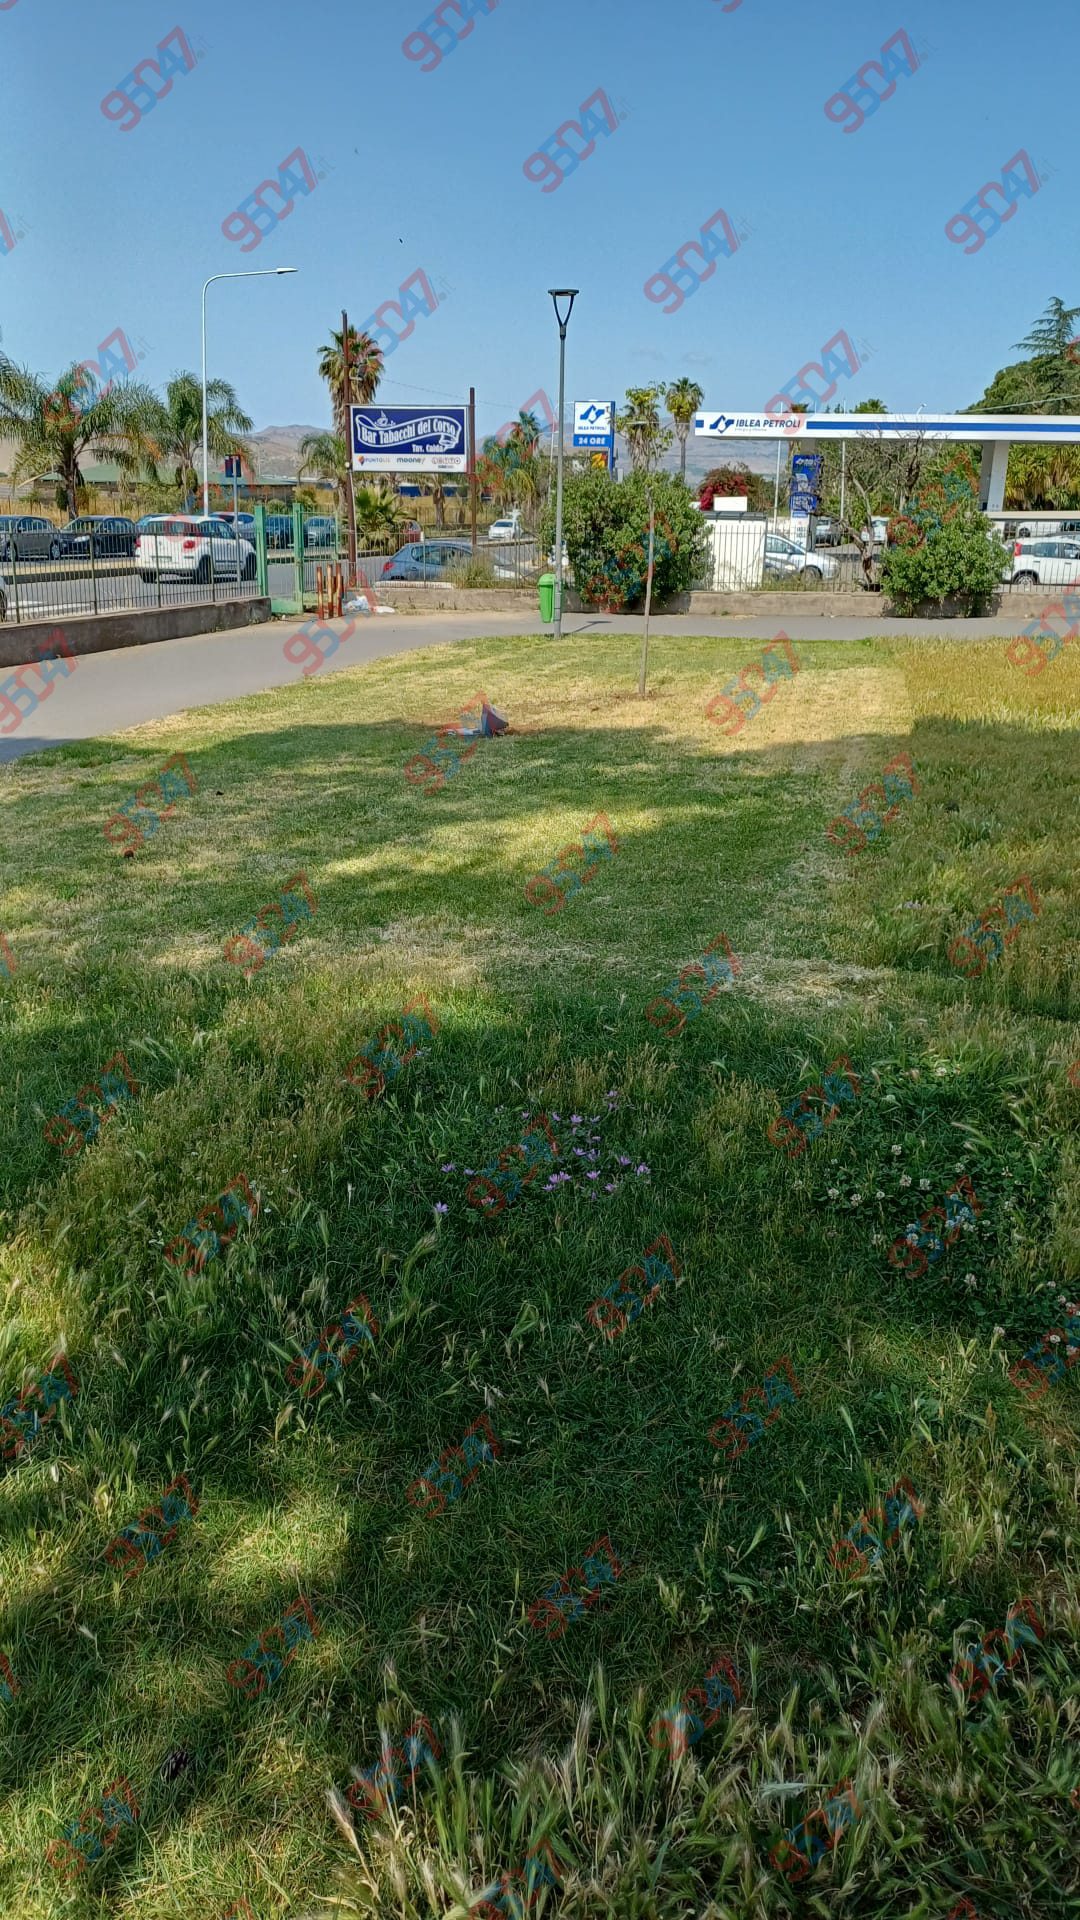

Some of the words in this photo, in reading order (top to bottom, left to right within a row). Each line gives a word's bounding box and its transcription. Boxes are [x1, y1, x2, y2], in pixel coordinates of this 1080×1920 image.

[736, 419, 761, 428] IBLEA
[763, 419, 801, 428] PETROLI
[362, 427, 377, 444] Bar
[379, 423, 415, 444] Tabacchi
[418, 419, 431, 435] del
[433, 419, 456, 436] Corso
[578, 437, 588, 445] 24
[590, 437, 606, 445] ORE
